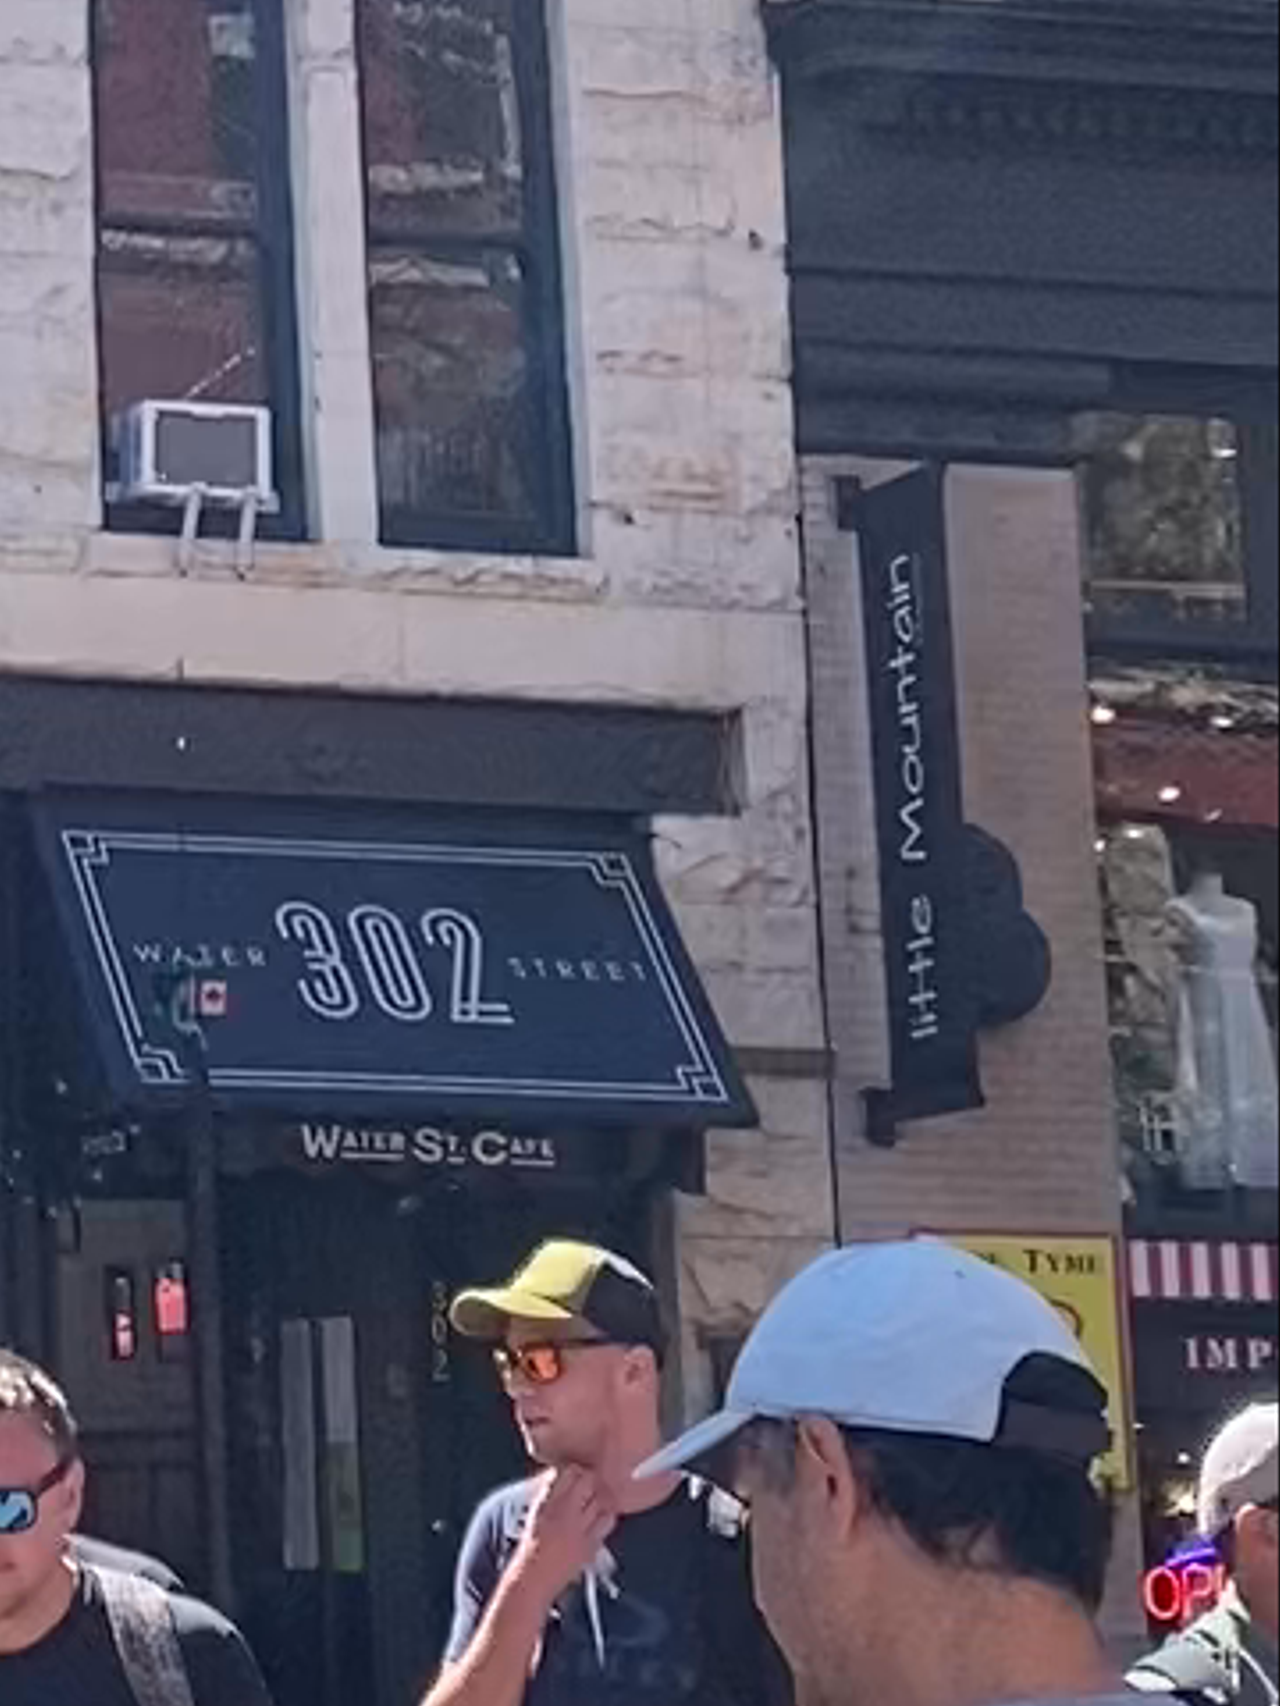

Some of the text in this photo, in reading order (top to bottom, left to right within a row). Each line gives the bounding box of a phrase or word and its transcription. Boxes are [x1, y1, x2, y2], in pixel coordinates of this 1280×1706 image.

[888, 553, 929, 862] Mountain
[132, 900, 648, 1024] WATER 302 STREET
